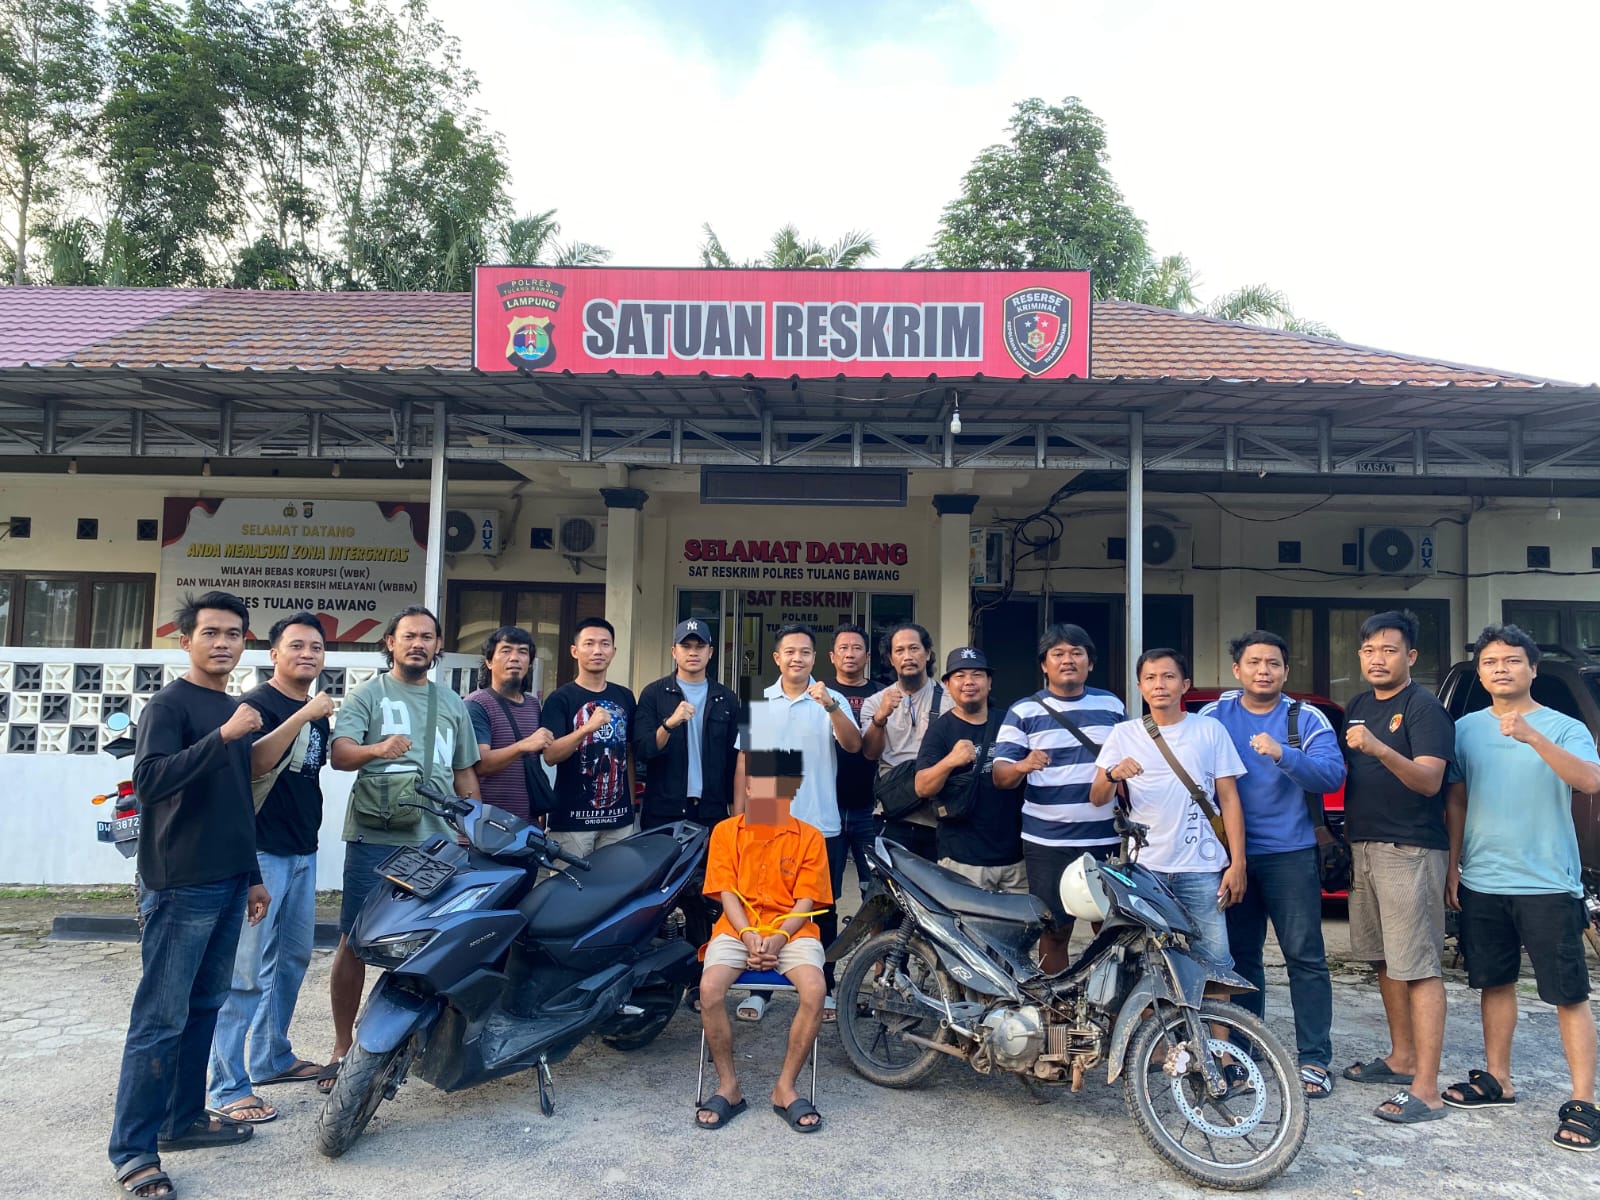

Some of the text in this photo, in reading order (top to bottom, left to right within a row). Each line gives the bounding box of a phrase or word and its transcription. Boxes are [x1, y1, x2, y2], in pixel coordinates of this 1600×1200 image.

[511, 279, 551, 288] POLRES
[506, 297, 556, 309] LAMPUNG
[1012, 292, 1063, 307] RESERSE
[1016, 302, 1057, 313] KRIMINAL
[583, 298, 984, 361] SATUAN RESKRIM
[241, 524, 356, 538] SELAMAT DATANG
[482, 519, 493, 550] AUX
[187, 543, 221, 558] ANDA
[224, 544, 289, 560] MEMASUKI
[292, 545, 325, 560] ZONA
[683, 539, 908, 566] SELAMAT DATANG
[1421, 537, 1433, 568] AUX
[220, 566, 370, 579] WILAYAH BEBAS KORUPSI (WBK)
[688, 565, 900, 581] SAT RESKRIM POLRES TULANG BAWANG
[176, 578, 418, 594] DAN WILAYAH BIROKRASI BERSIH MELAYANI (WBBM)
[263, 597, 314, 610] TULANG
[317, 599, 377, 611] BAWANG
[746, 590, 853, 609] SAT RESKRIM
[782, 612, 818, 622] POLRES
[570, 810, 605, 818] PHILIPP
[584, 817, 617, 825] ORIGINALS
[115, 817, 140, 831] 3872
